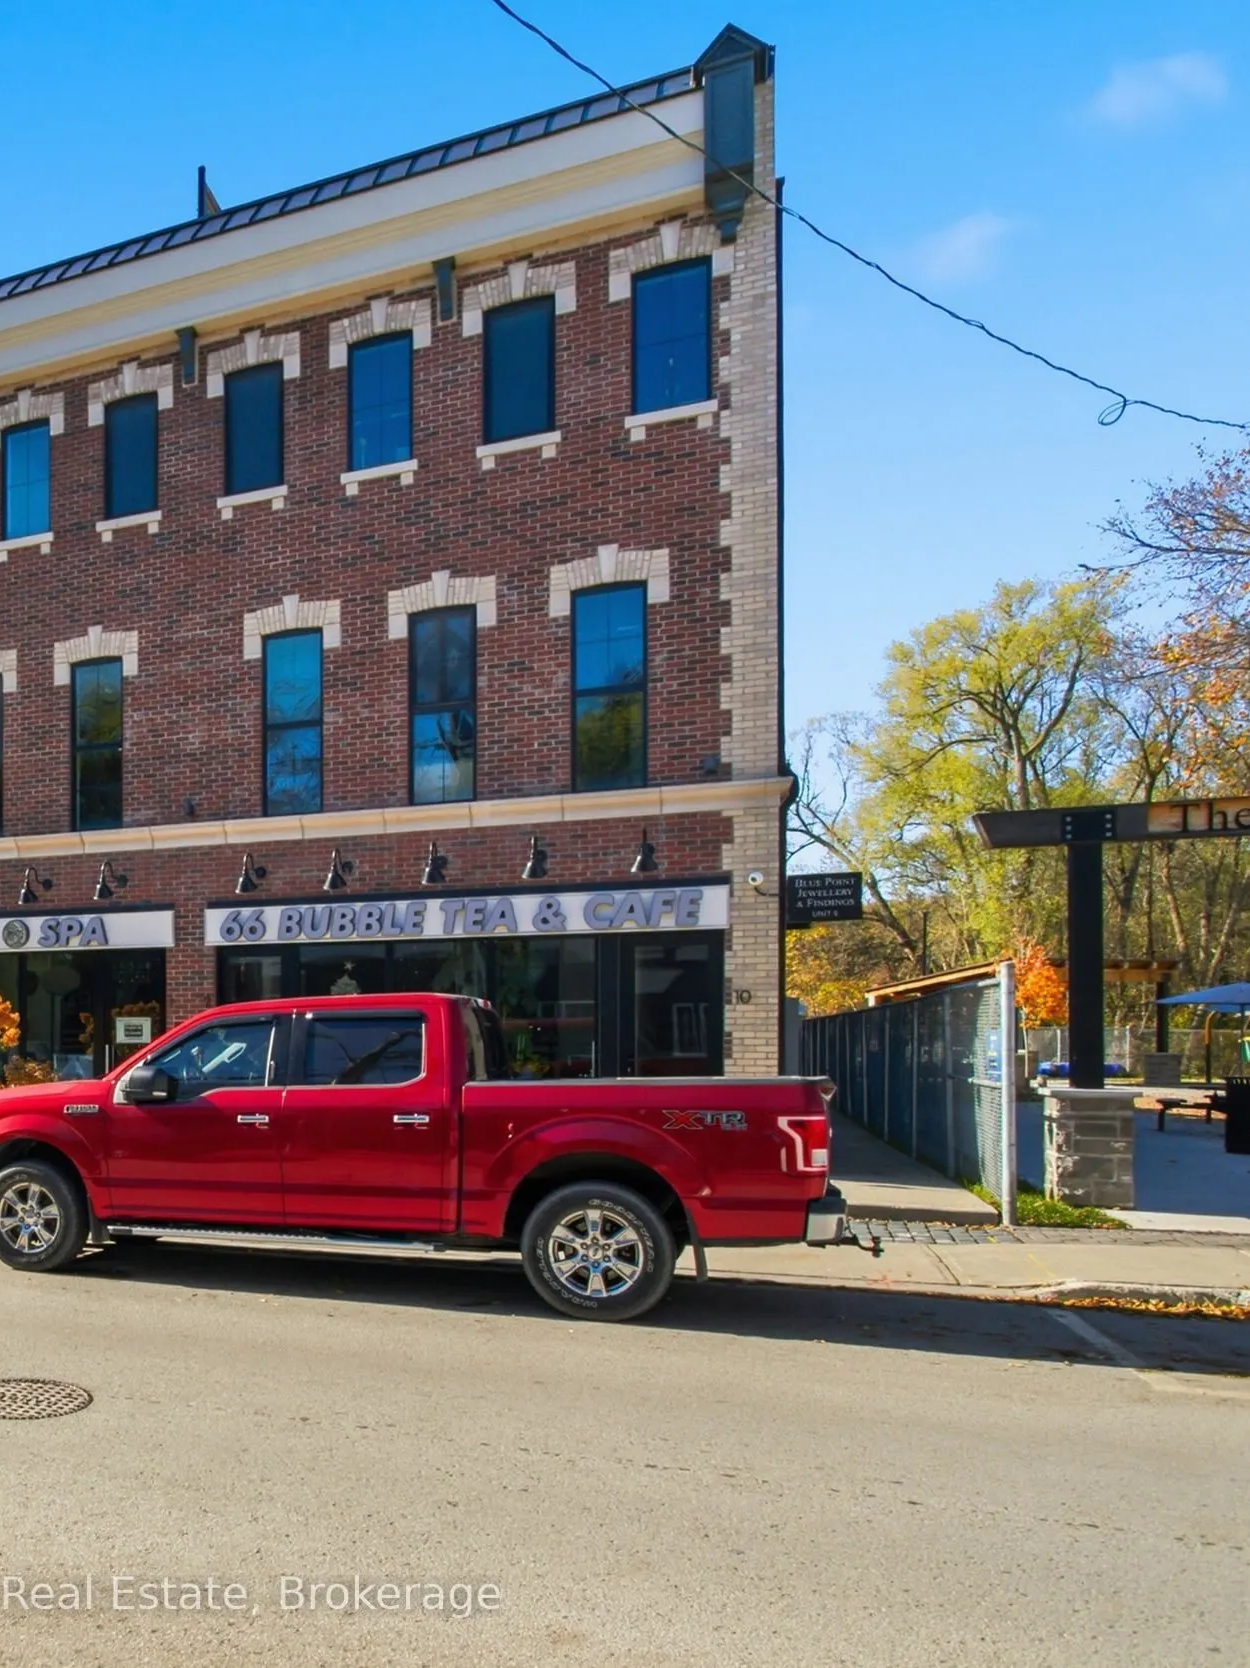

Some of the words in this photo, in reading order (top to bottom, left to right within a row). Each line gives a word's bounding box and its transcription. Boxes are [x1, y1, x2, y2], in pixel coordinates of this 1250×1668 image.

[1169, 798, 1250, 833] The
[37, 915, 110, 948] SPA
[219, 909, 266, 942] 66
[277, 901, 426, 940] BUBBLE
[440, 897, 518, 934] TEA
[533, 896, 567, 931] &
[583, 889, 703, 930] CAFE
[662, 1110, 747, 1130] XTR
